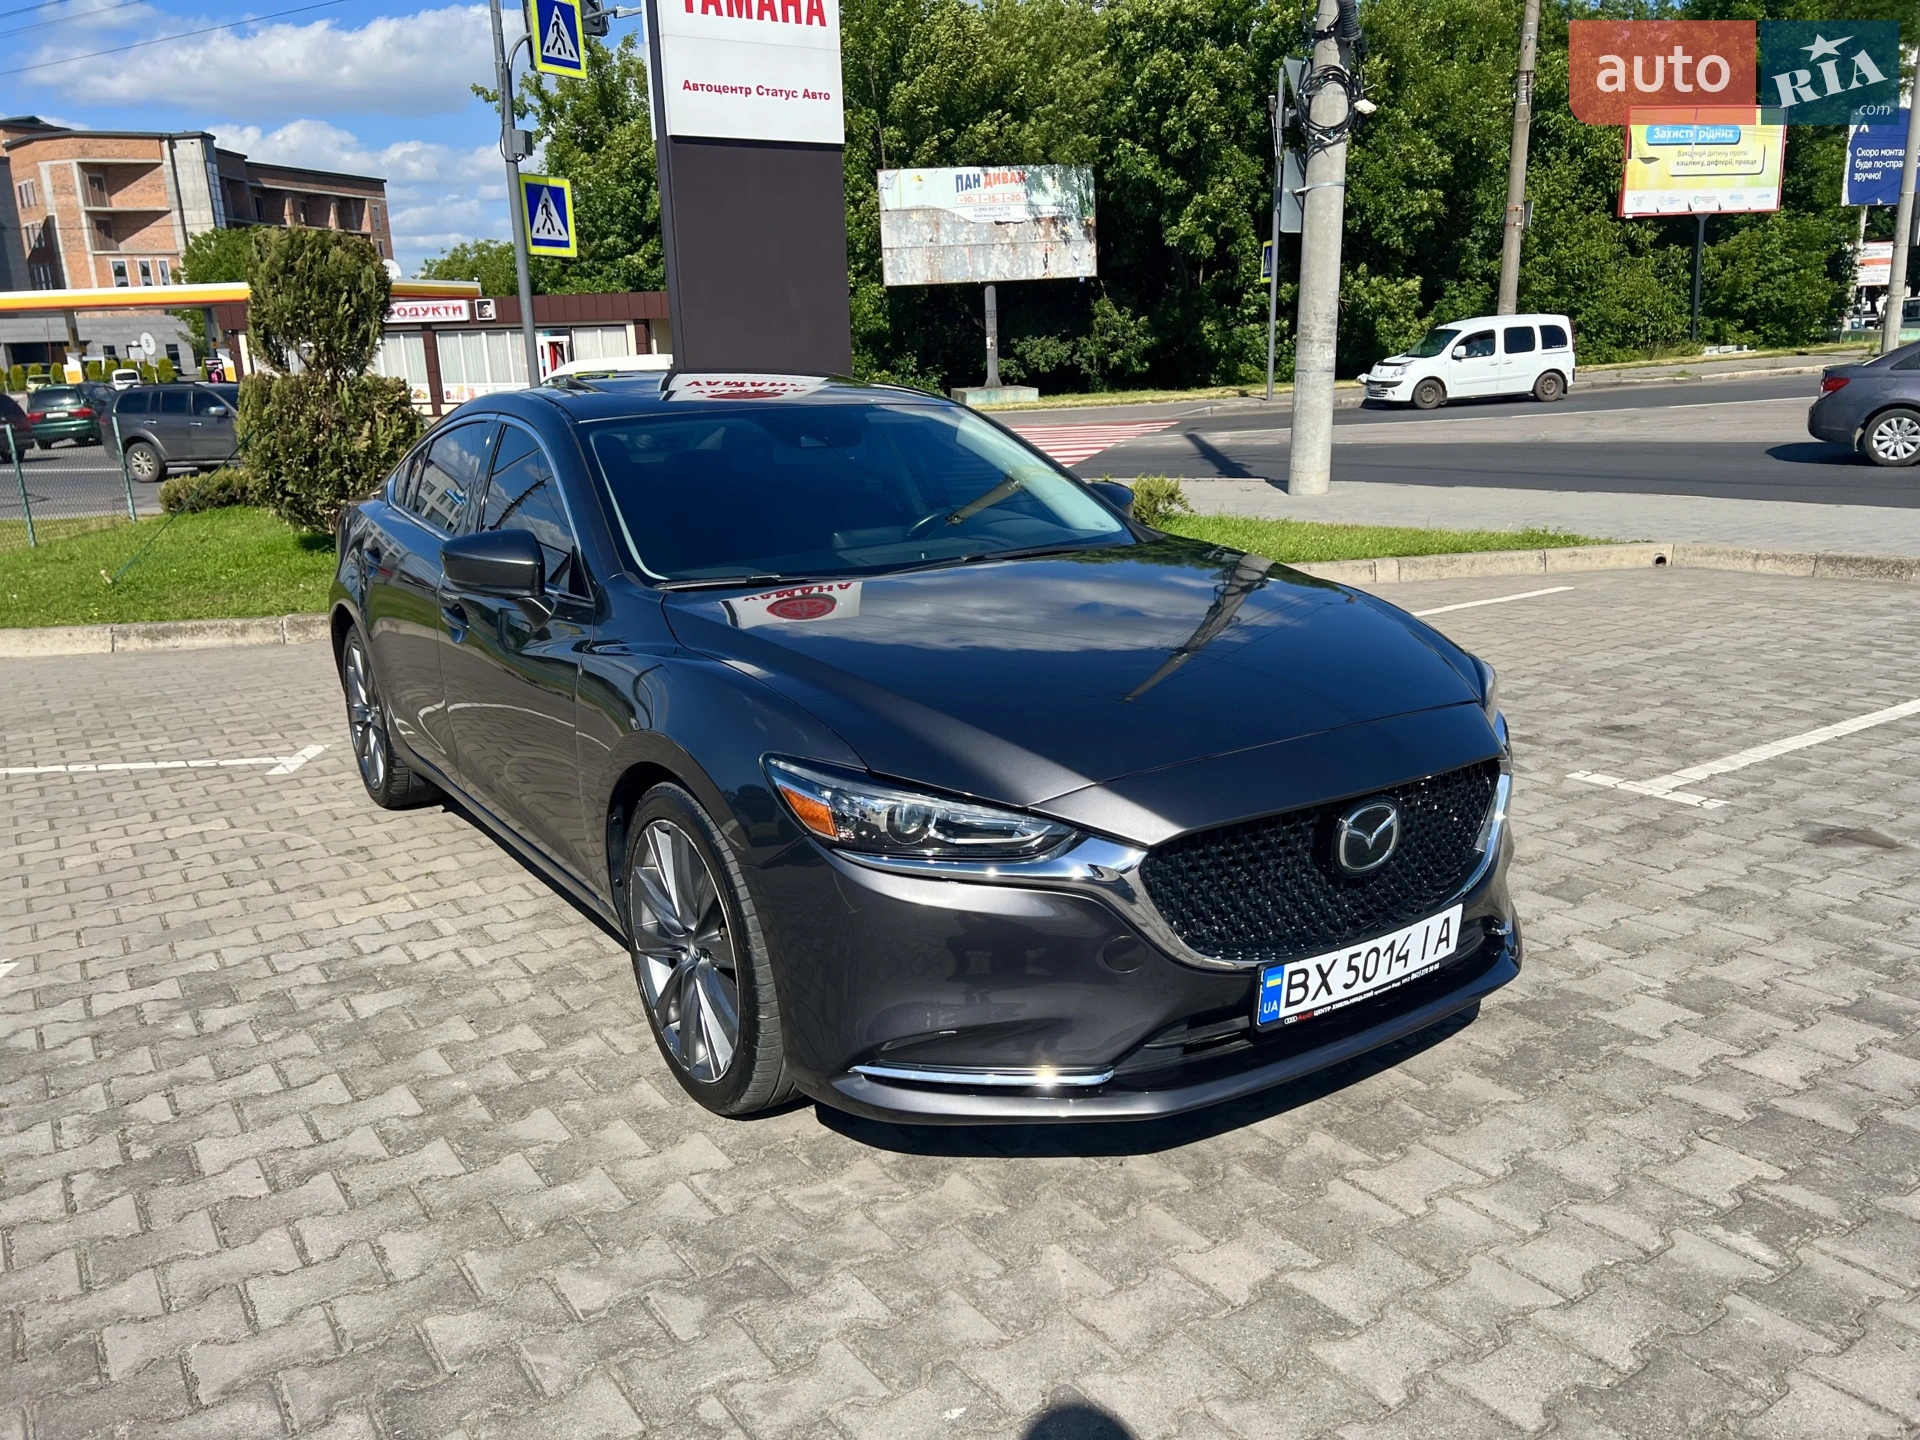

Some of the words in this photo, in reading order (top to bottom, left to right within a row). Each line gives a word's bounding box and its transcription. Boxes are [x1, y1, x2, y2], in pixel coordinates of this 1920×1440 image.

[682, 80, 752, 98] Автоцентр
[756, 85, 798, 101] Статус
[802, 88, 831, 101] Авто
[1698, 127, 1734, 141] рідних
[1707, 150, 1729, 158] дитину
[1856, 147, 1880, 158] Скоро
[1855, 159, 1873, 170] буде
[955, 173, 981, 193] ПАН
[983, 170, 1026, 189] ДИВАН
[1853, 171, 1882, 182] зручно!
[1284, 958, 1338, 1009] BX
[1342, 932, 1412, 991] 5014
[1420, 915, 1451, 961] IA
[1263, 1000, 1279, 1014] UA
[1297, 1009, 1314, 1022] Audi
